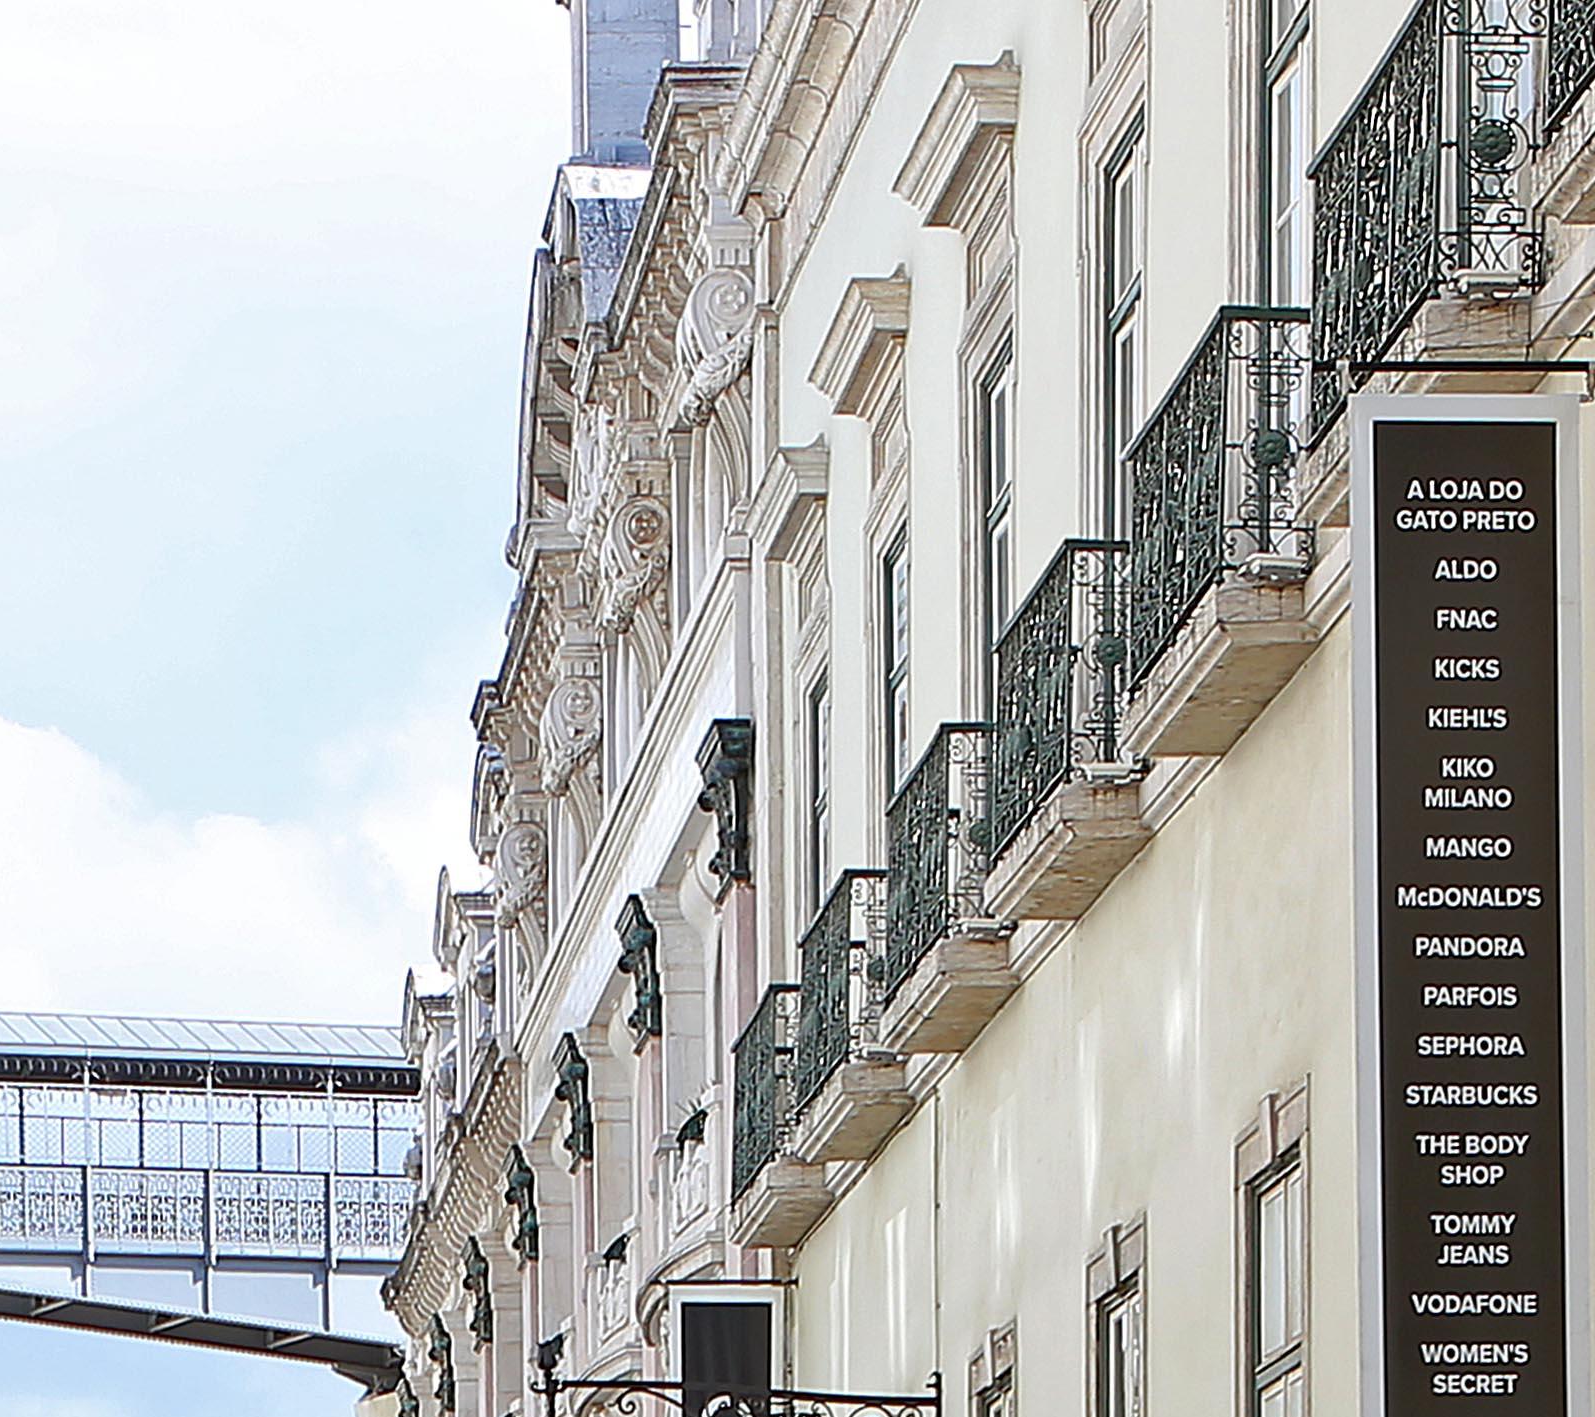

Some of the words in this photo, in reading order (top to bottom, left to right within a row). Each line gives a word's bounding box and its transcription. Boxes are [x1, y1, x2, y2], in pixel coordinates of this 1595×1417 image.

[1407, 480, 1425, 500] A
[1429, 480, 1485, 500] LOJA
[1489, 480, 1523, 500] DO
[1396, 509, 1458, 530] GATO
[1462, 509, 1535, 530] PRETO
[1434, 559, 1497, 580] ALDO
[1436, 609, 1497, 629] FNAC
[1435, 658, 1500, 679] KICKS
[1428, 708, 1507, 728] KIEHL'S
[1442, 757, 1494, 778] KIKO
[1425, 788, 1512, 808] MILANO
[1426, 837, 1512, 857] MANGO
[1397, 886, 1542, 907] McDONALD'S
[1415, 937, 1525, 957] PANDORA
[1424, 986, 1517, 1006] PARFOIS
[1418, 1035, 1525, 1056] SEPHORA
[1406, 1085, 1538, 1105] STARBUCKS
[1415, 1134, 1460, 1154] THE
[1465, 1134, 1530, 1154] BODY
[1441, 1165, 1504, 1185] SHOP
[1430, 1214, 1516, 1234] TOMMY
[1437, 1245, 1509, 1265] JEANS
[1411, 1294, 1537, 1314] VODAFONE
[1420, 1343, 1529, 1363] WOMEN'S
[1433, 1374, 1518, 1394] SECRET
